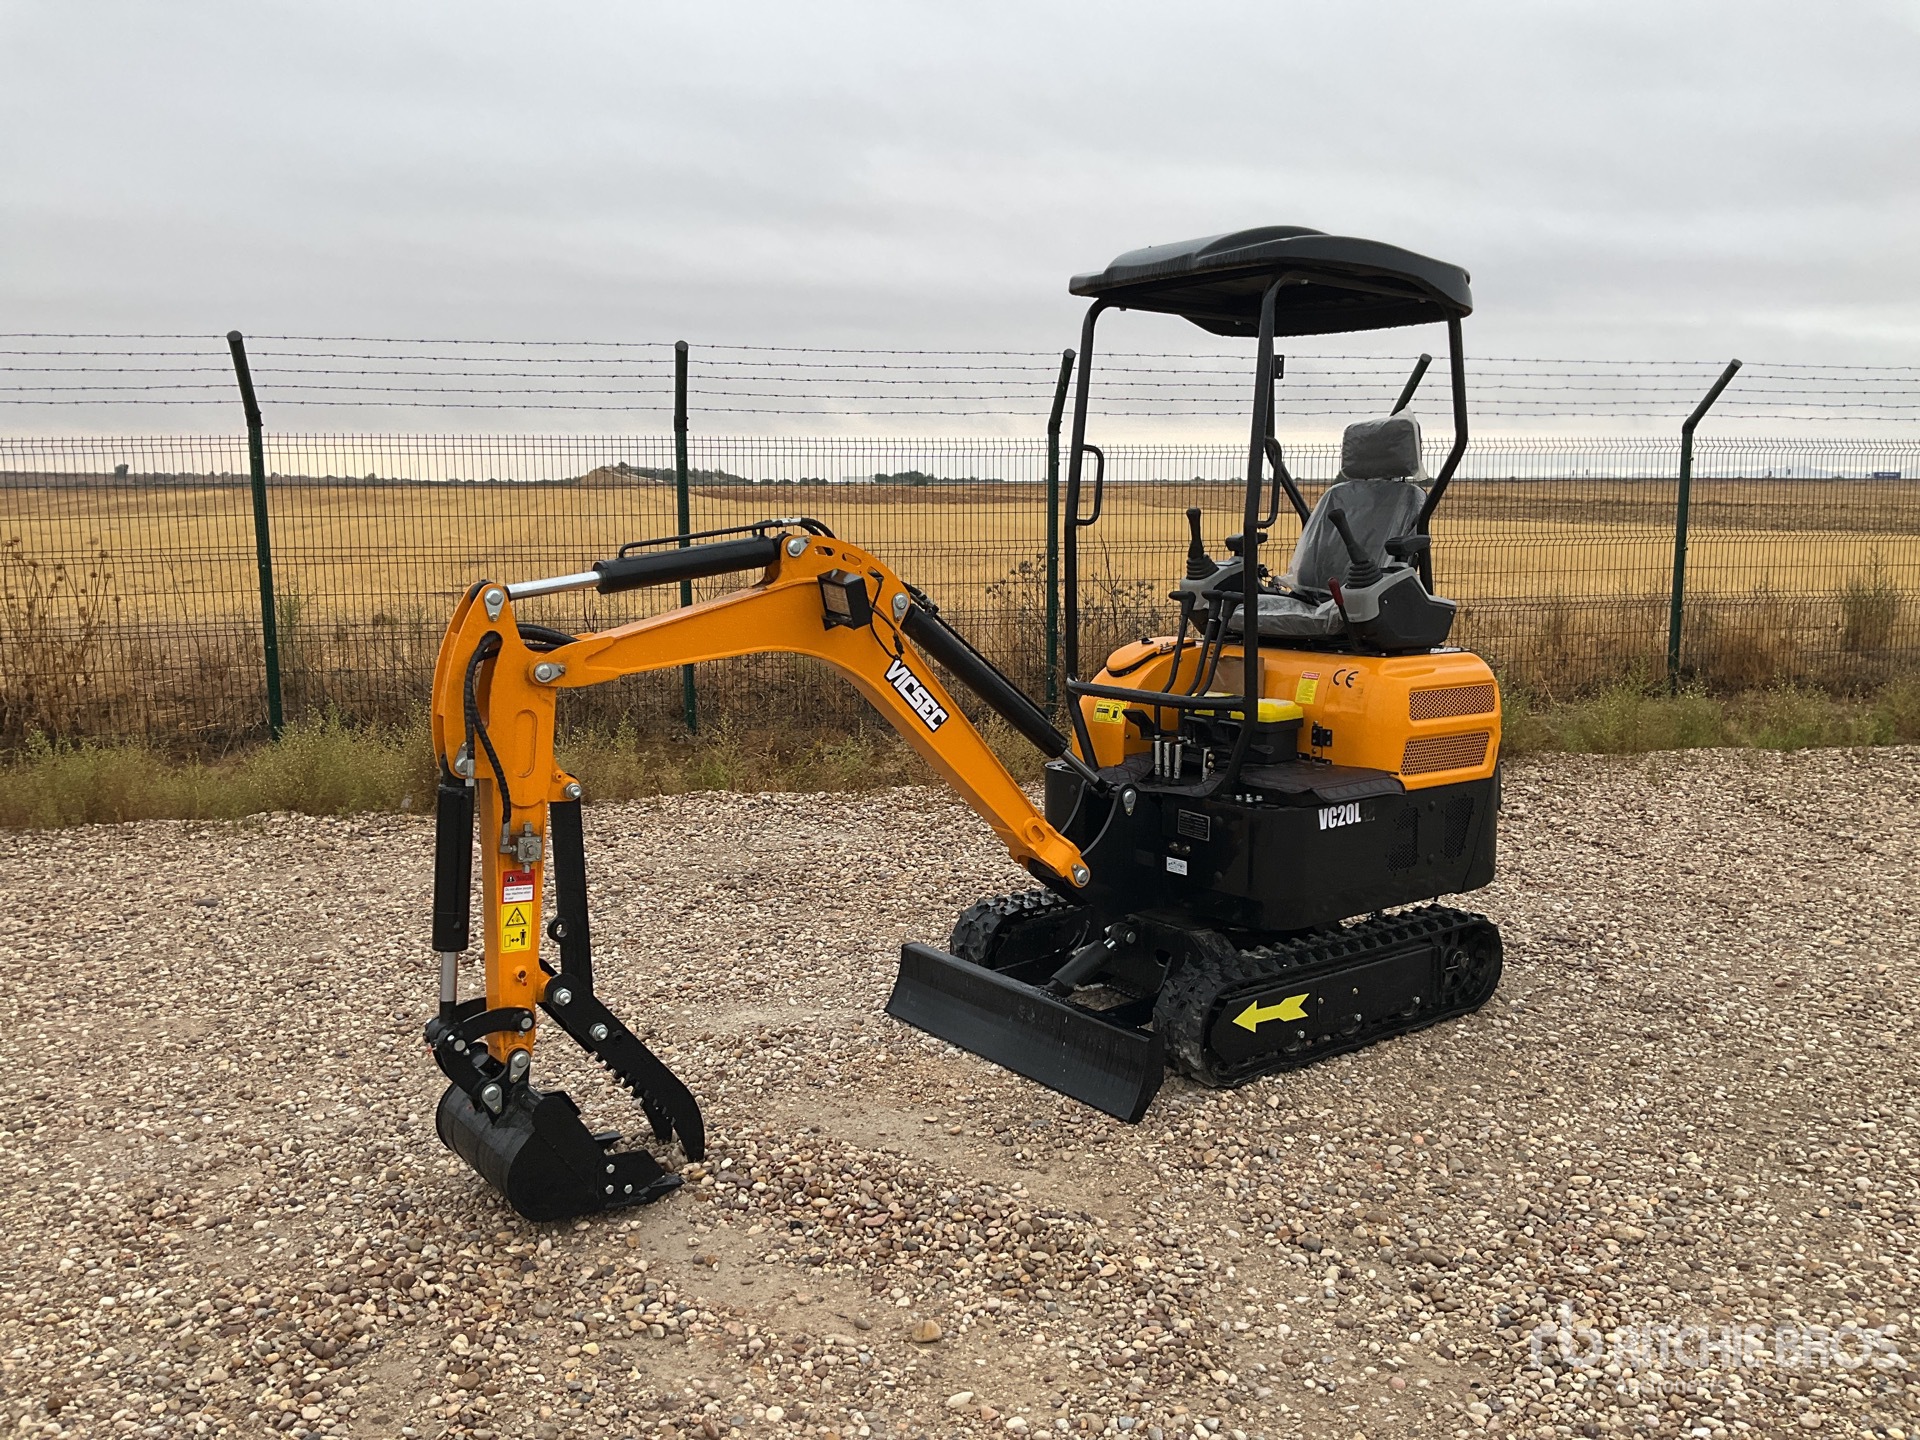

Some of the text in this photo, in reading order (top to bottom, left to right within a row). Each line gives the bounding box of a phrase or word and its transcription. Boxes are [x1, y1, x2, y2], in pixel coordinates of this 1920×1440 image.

[1333, 669, 1359, 688] CE
[885, 659, 949, 732] VICSEC
[1318, 802, 1362, 830] VC20L
